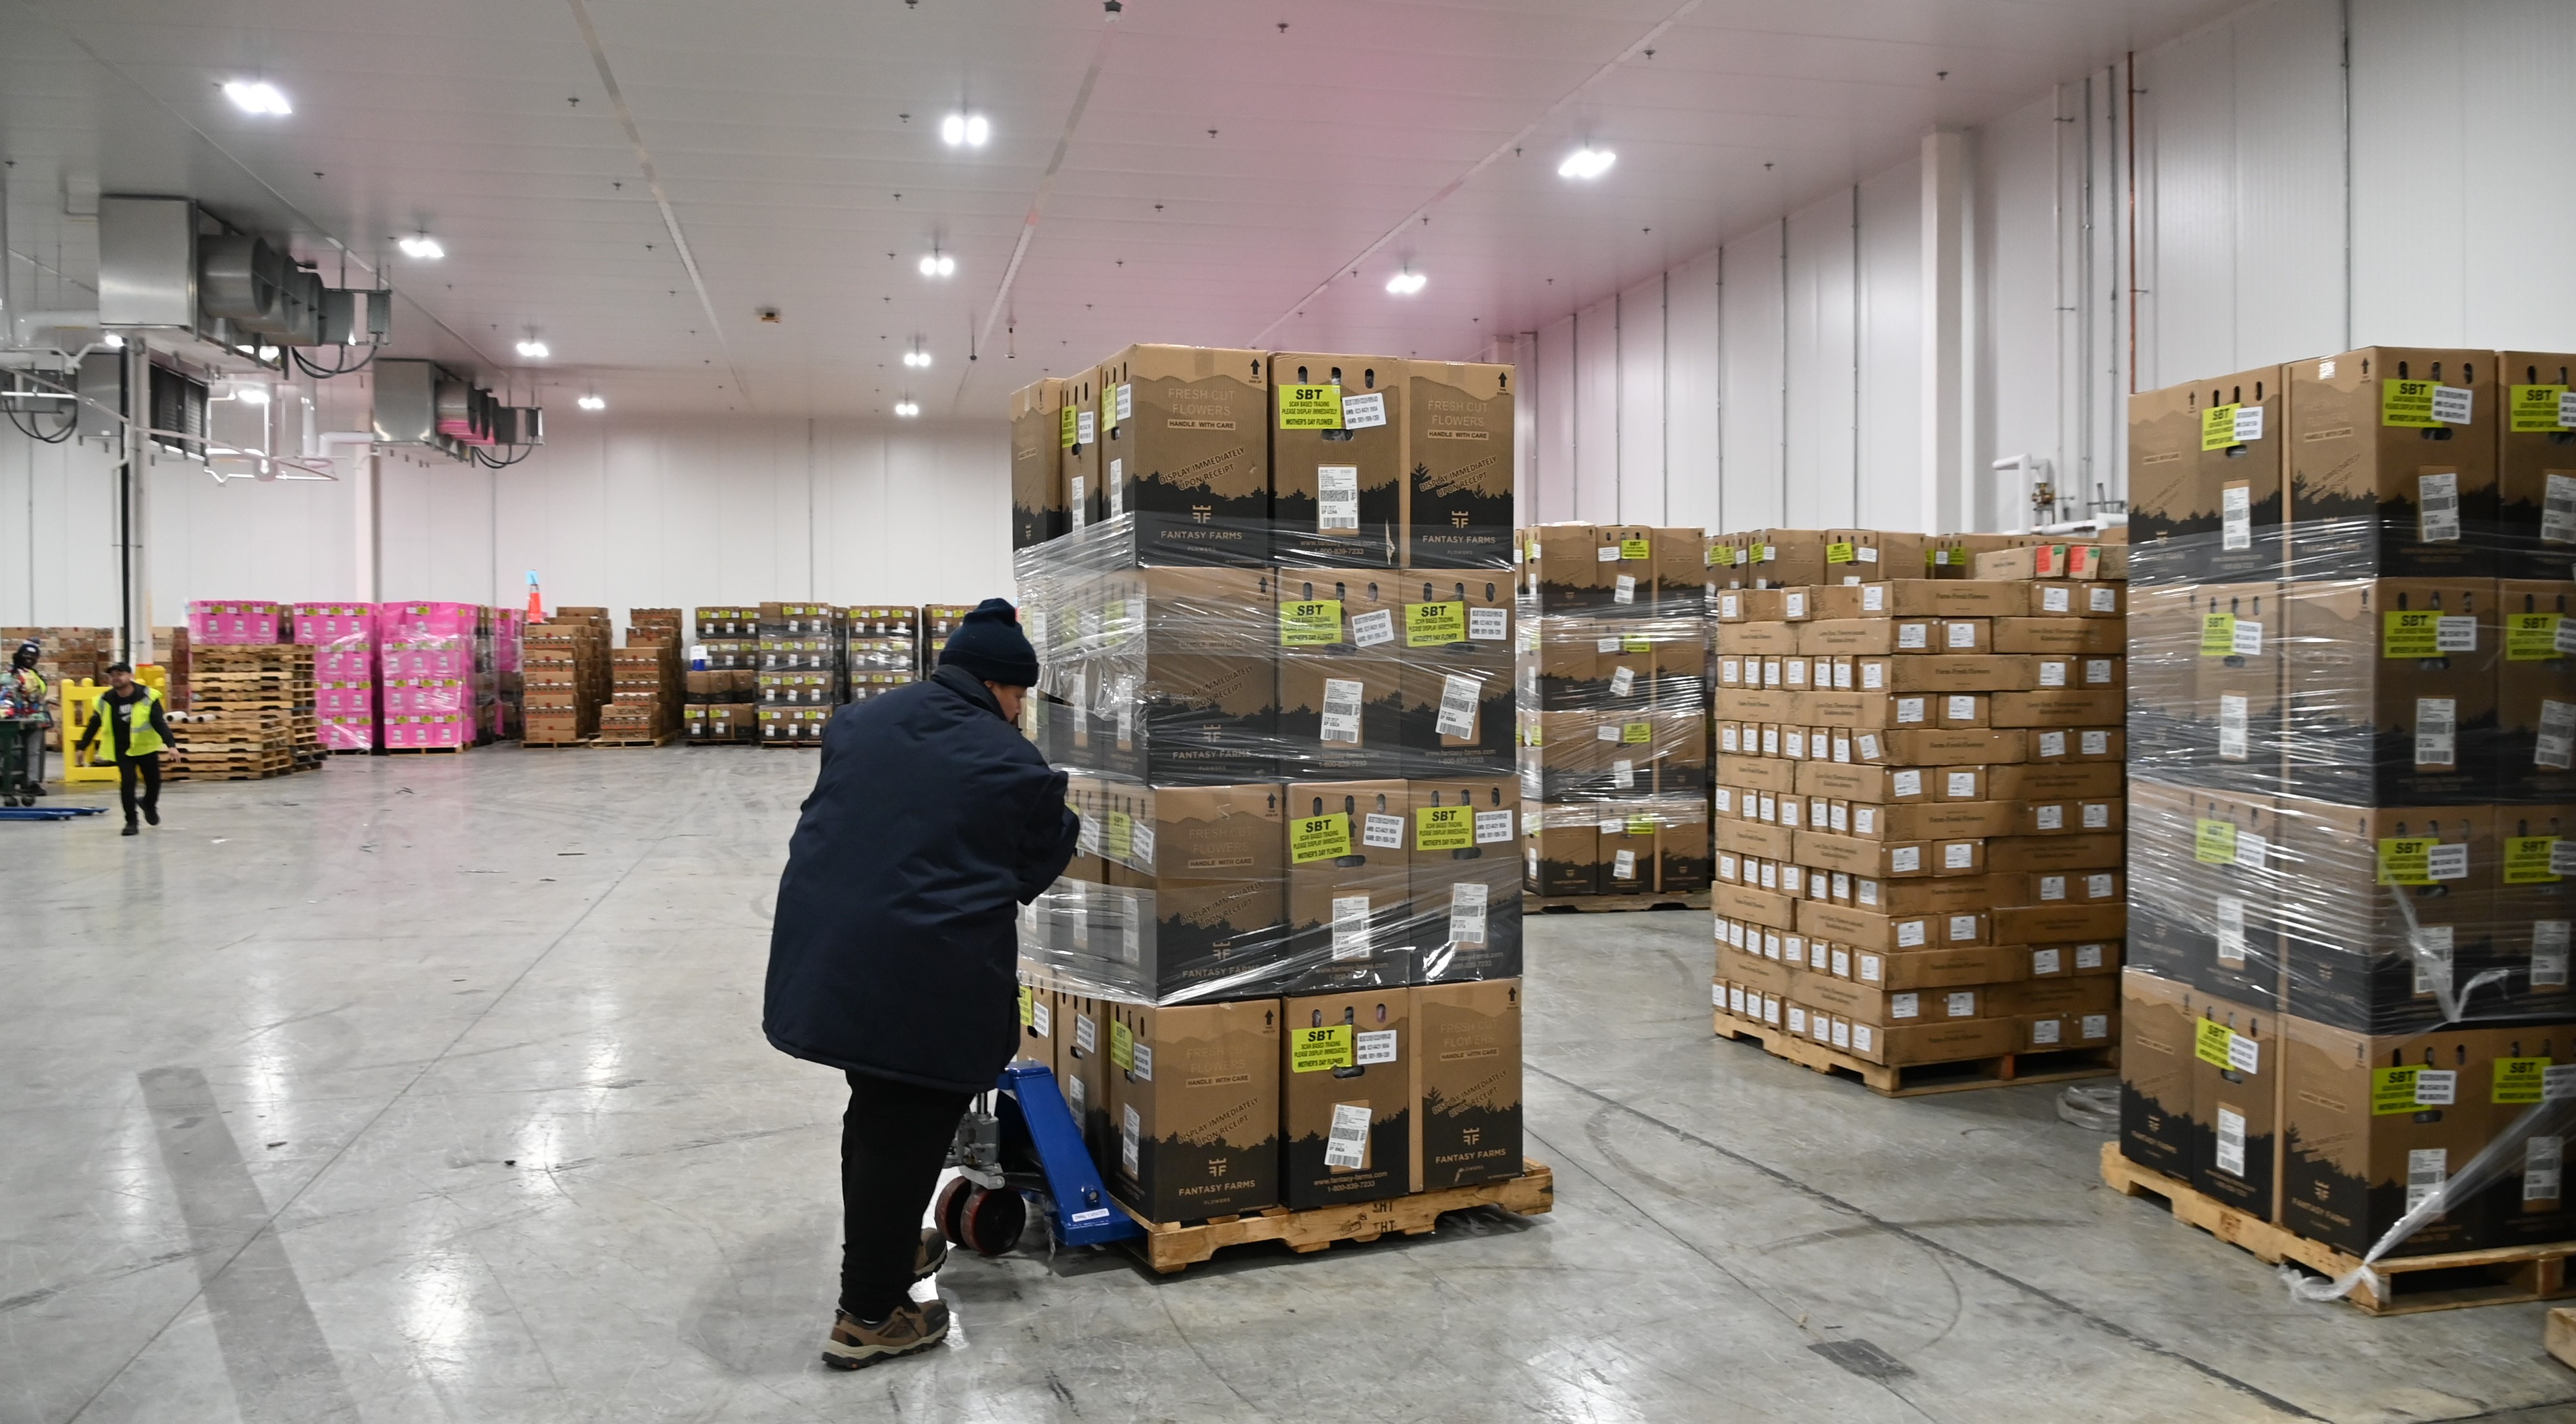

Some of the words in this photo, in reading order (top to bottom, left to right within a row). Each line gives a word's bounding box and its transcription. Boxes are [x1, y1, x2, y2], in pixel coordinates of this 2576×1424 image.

[1169, 388, 1207, 399] FRESH
[1211, 391, 1235, 400] CUT
[1296, 389, 1323, 400] SBT
[2399, 383, 2427, 395] SBT
[2526, 389, 2552, 400] SBT
[1173, 404, 1231, 416] FLOWERS
[1428, 401, 1462, 411] FRESH
[1467, 402, 1487, 412] CUT
[2213, 408, 2230, 420] SBT
[1432, 416, 1483, 426] FLOWERS
[1159, 467, 1191, 484] DISPLAY
[1193, 447, 1244, 472] IMMEDIATELY
[1179, 476, 1202, 490] UPON
[1205, 464, 1235, 480] RECEIPT
[1420, 474, 1449, 491] DISPLAY
[1450, 456, 1497, 479] IMMEDIATELY
[1437, 484, 1459, 497] UPON
[1460, 472, 1487, 488] RECEIPT
[1297, 605, 1324, 616] SBT
[1421, 606, 1447, 616] SBT
[2401, 615, 2428, 626] SBT
[2522, 617, 2548, 629] SBT
[1170, 688, 1203, 706] DISPLAY
[1204, 665, 1254, 695] IMMEDIATELY
[1190, 697, 1213, 711] UPON
[1213, 682, 1243, 702] RECEIPT
[1432, 811, 1457, 821] SBT
[1306, 819, 1332, 832] SBT
[1189, 829, 1227, 839] FRESH
[1323, 836, 1346, 845] IMMEDIATELY
[2521, 841, 2547, 852] SBT
[1193, 842, 1247, 853] FLOWERS
[2395, 842, 2423, 853] SBT
[1297, 851, 1317, 859] MOTHER'S
[1180, 906, 1211, 925] DISPLAY
[1212, 881, 1262, 909] IMMEDIATELY
[1199, 914, 1222, 929] UPON
[1224, 899, 1252, 917] RECEIPT
[1182, 968, 1227, 978] FANTASY
[1308, 1030, 1335, 1042] SBT
[1191, 1059, 1244, 1073] FLOWERS
[2509, 1062, 2535, 1073] SBT
[2388, 1071, 2414, 1084] SBT
[1461, 1070, 1506, 1099] IMMEDIATELY
[1472, 1086, 1498, 1105] RECEIPT
[1178, 1122, 1208, 1144] DISPLAY
[1209, 1097, 1260, 1126] IMMEDIATELY
[1196, 1131, 1219, 1148] UPON
[1220, 1114, 1248, 1134] RECEIPT
[1436, 1152, 1475, 1164] FANTASY
[1478, 1148, 1506, 1158] FARMS
[1179, 1184, 1222, 1196] FANTASY
[1225, 1180, 1256, 1190] FARMS
